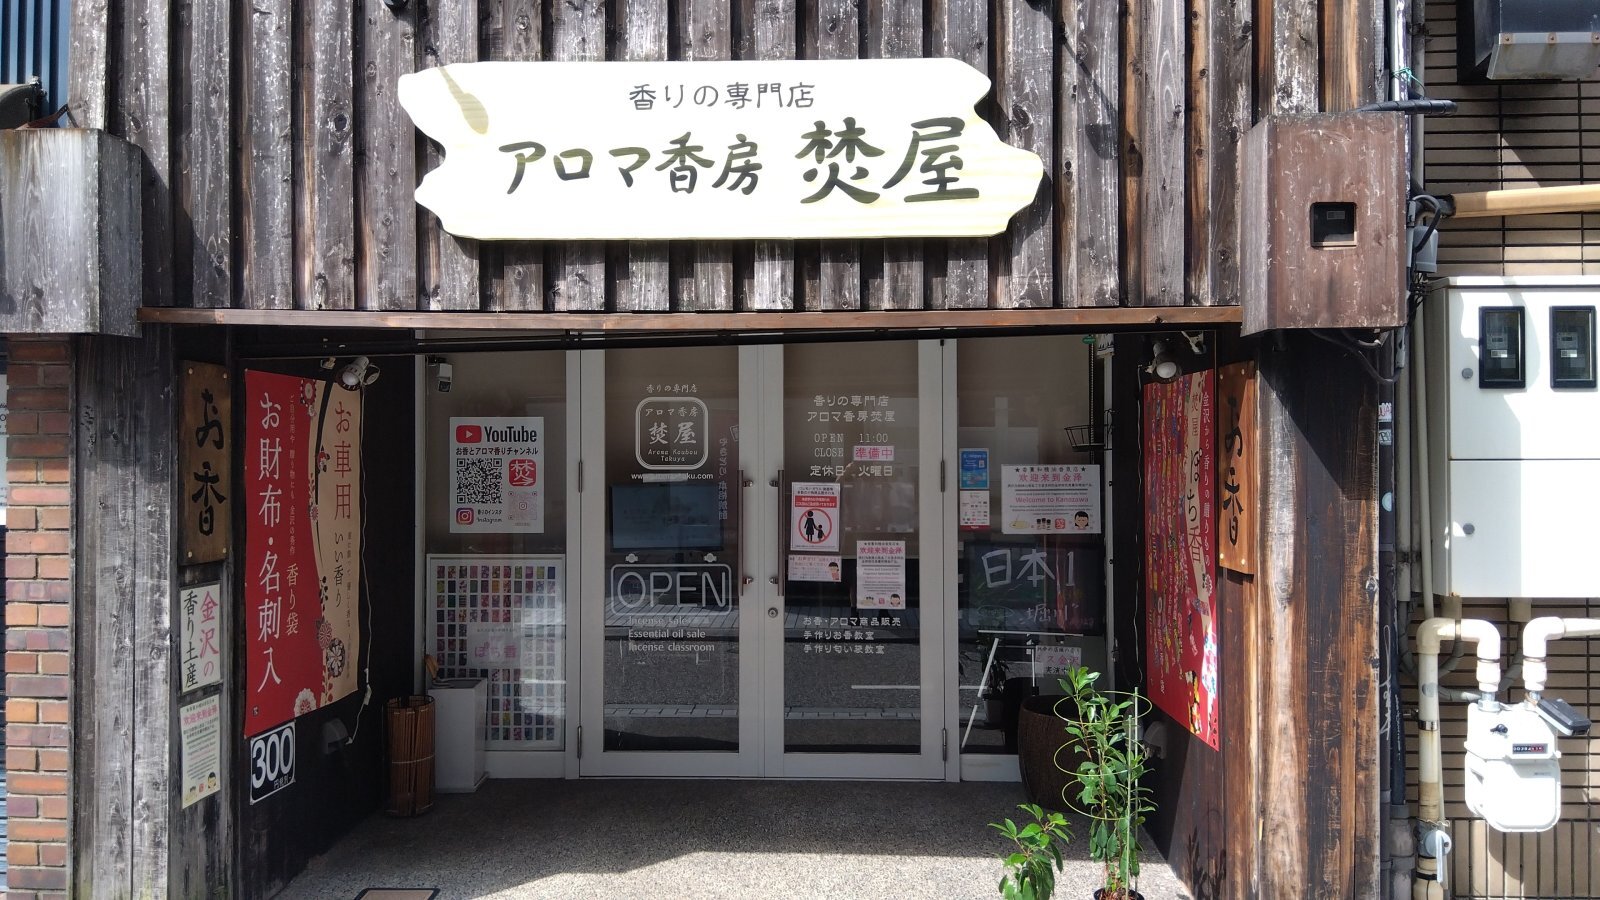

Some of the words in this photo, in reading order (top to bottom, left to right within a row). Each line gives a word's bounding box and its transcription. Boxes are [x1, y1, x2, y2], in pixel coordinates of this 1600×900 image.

[629, 82, 816, 109] 香りの専門店
[499, 131, 763, 195] アロマ香房
[796, 117, 980, 203] 焚屋
[646, 383, 698, 393] 香りの専門店
[813, 395, 889, 406] 香りの専門店
[645, 406, 698, 417] アロマ香房
[807, 410, 896, 422] アロマ香房焚屋
[484, 426, 537, 442] YouTube
[648, 421, 697, 445] 焚屋
[814, 433, 844, 442] OPEN
[859, 433, 888, 442] 11:00
[455, 447, 538, 456] お香とアロマ香りチャンネル
[814, 448, 844, 457] CLOSE
[855, 447, 893, 459] 準備中
[191, 388, 227, 536] お香
[334, 401, 352, 520] お車用
[810, 465, 845, 476] 定休日
[858, 465, 893, 476] 火曜日
[257, 392, 282, 692] お財布・名刺入
[334, 532, 344, 608] いい香り
[617, 571, 727, 608] OPEN
[286, 563, 299, 635] 香り袋
[802, 616, 901, 627] お香・アロマ商品販売
[183, 591, 198, 688] 香り土産
[199, 591, 219, 677] 金沢の
[628, 629, 669, 638] Essential
[672, 629, 684, 638] oil
[686, 629, 706, 638] sale
[803, 630, 875, 640] 手作りお香教室
[628, 642, 664, 651] Incense
[668, 642, 715, 651] classroom
[252, 727, 293, 789] 300
